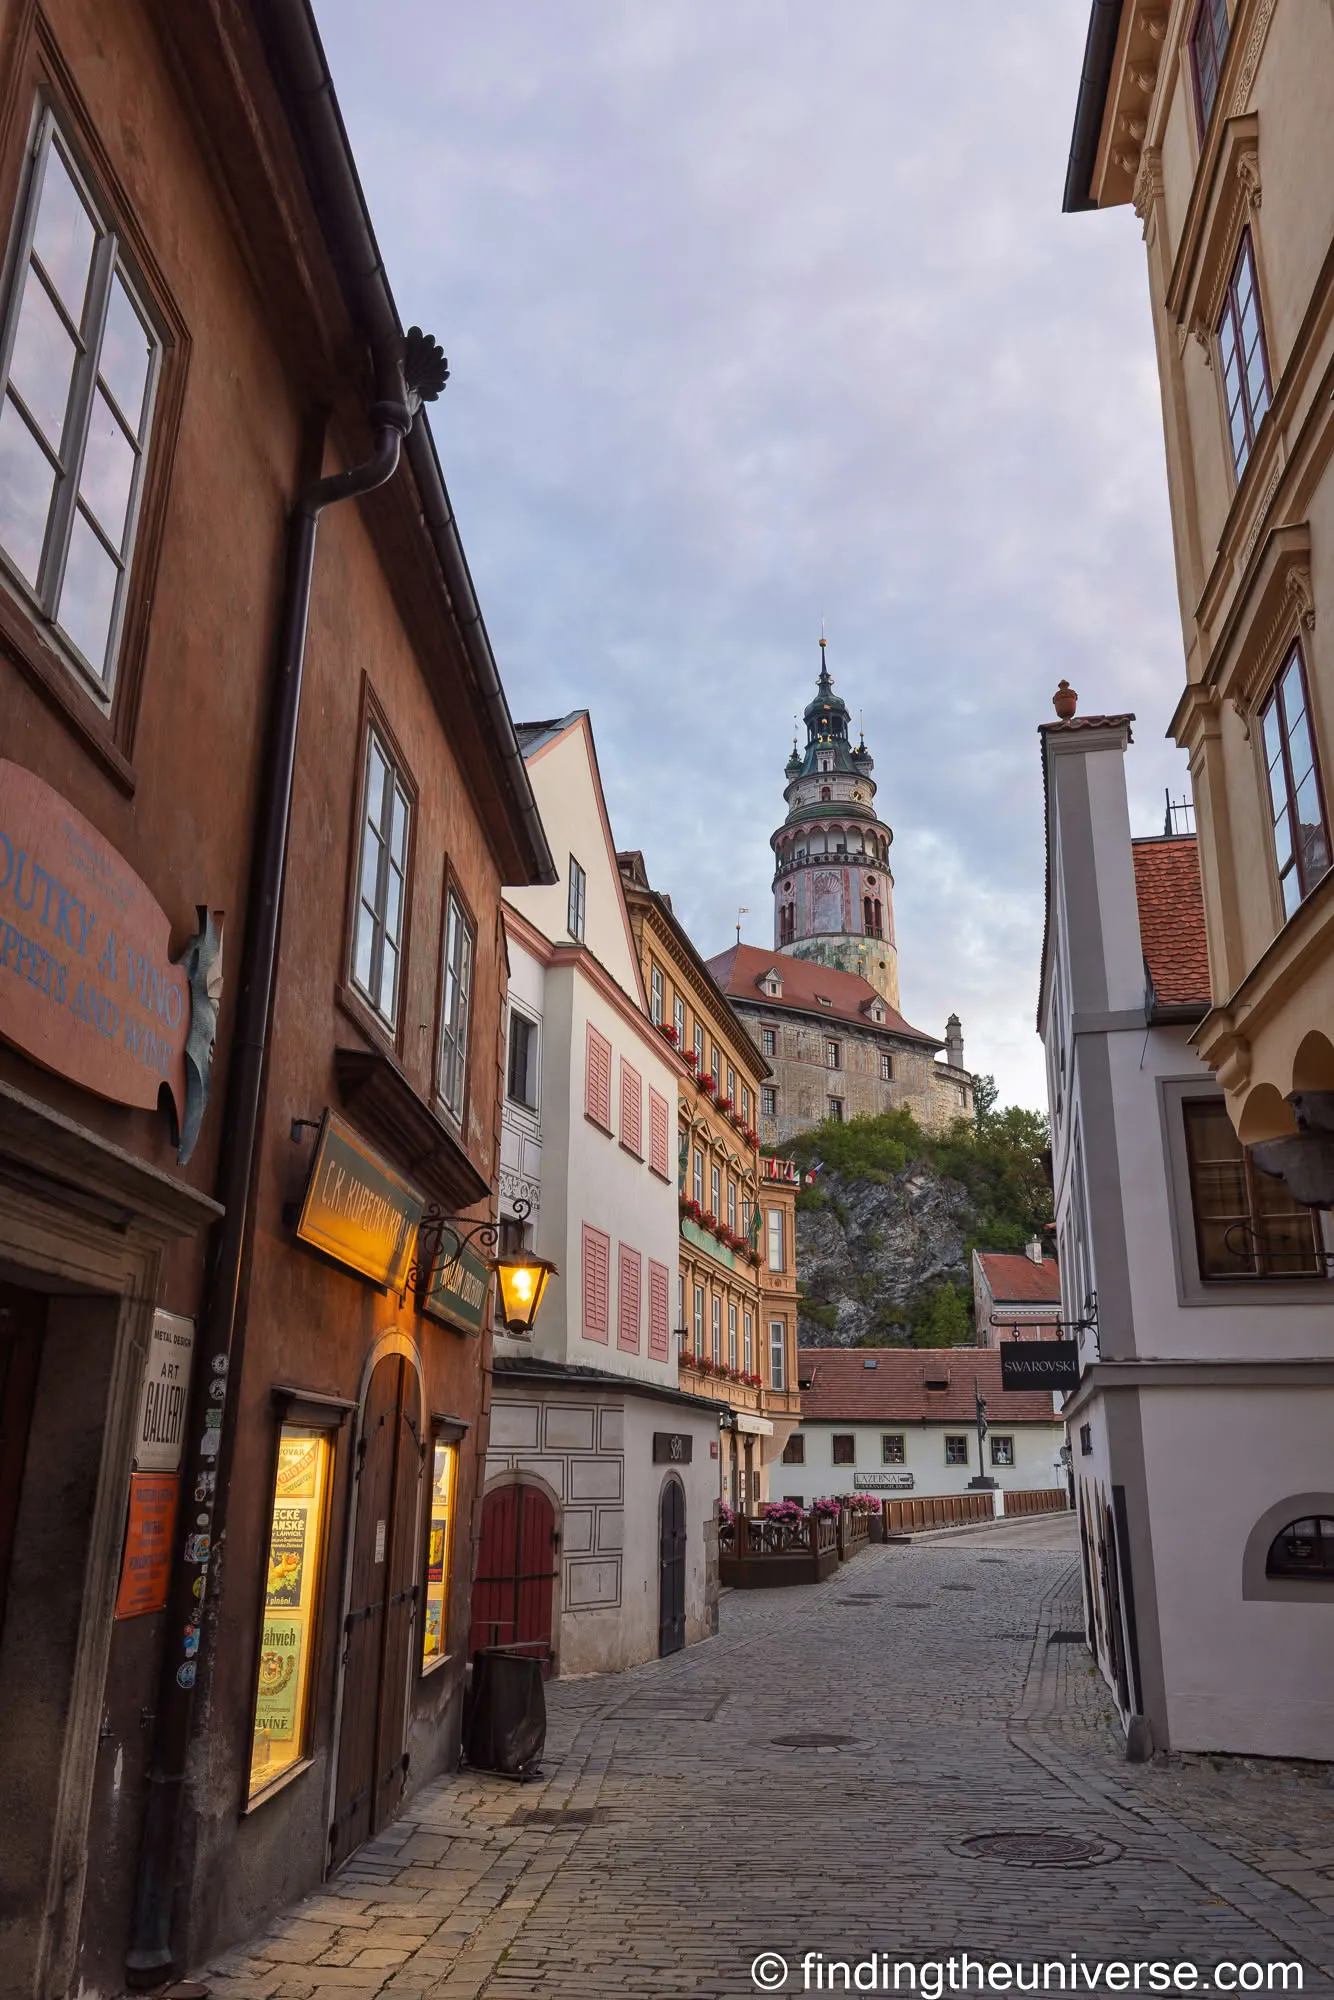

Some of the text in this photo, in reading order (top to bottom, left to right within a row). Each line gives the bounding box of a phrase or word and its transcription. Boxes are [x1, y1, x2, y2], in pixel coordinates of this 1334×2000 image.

[0, 917, 173, 1079] PPETS AND WINE
[98, 930, 118, 981] A
[127, 947, 182, 1028] VÍNO
[154, 1328, 192, 1348] METAL DESIGN
[160, 1361, 179, 1380] ART
[1003, 1360, 1076, 1373] SWAROVSKI
[142, 1381, 187, 1445] GALLERY
